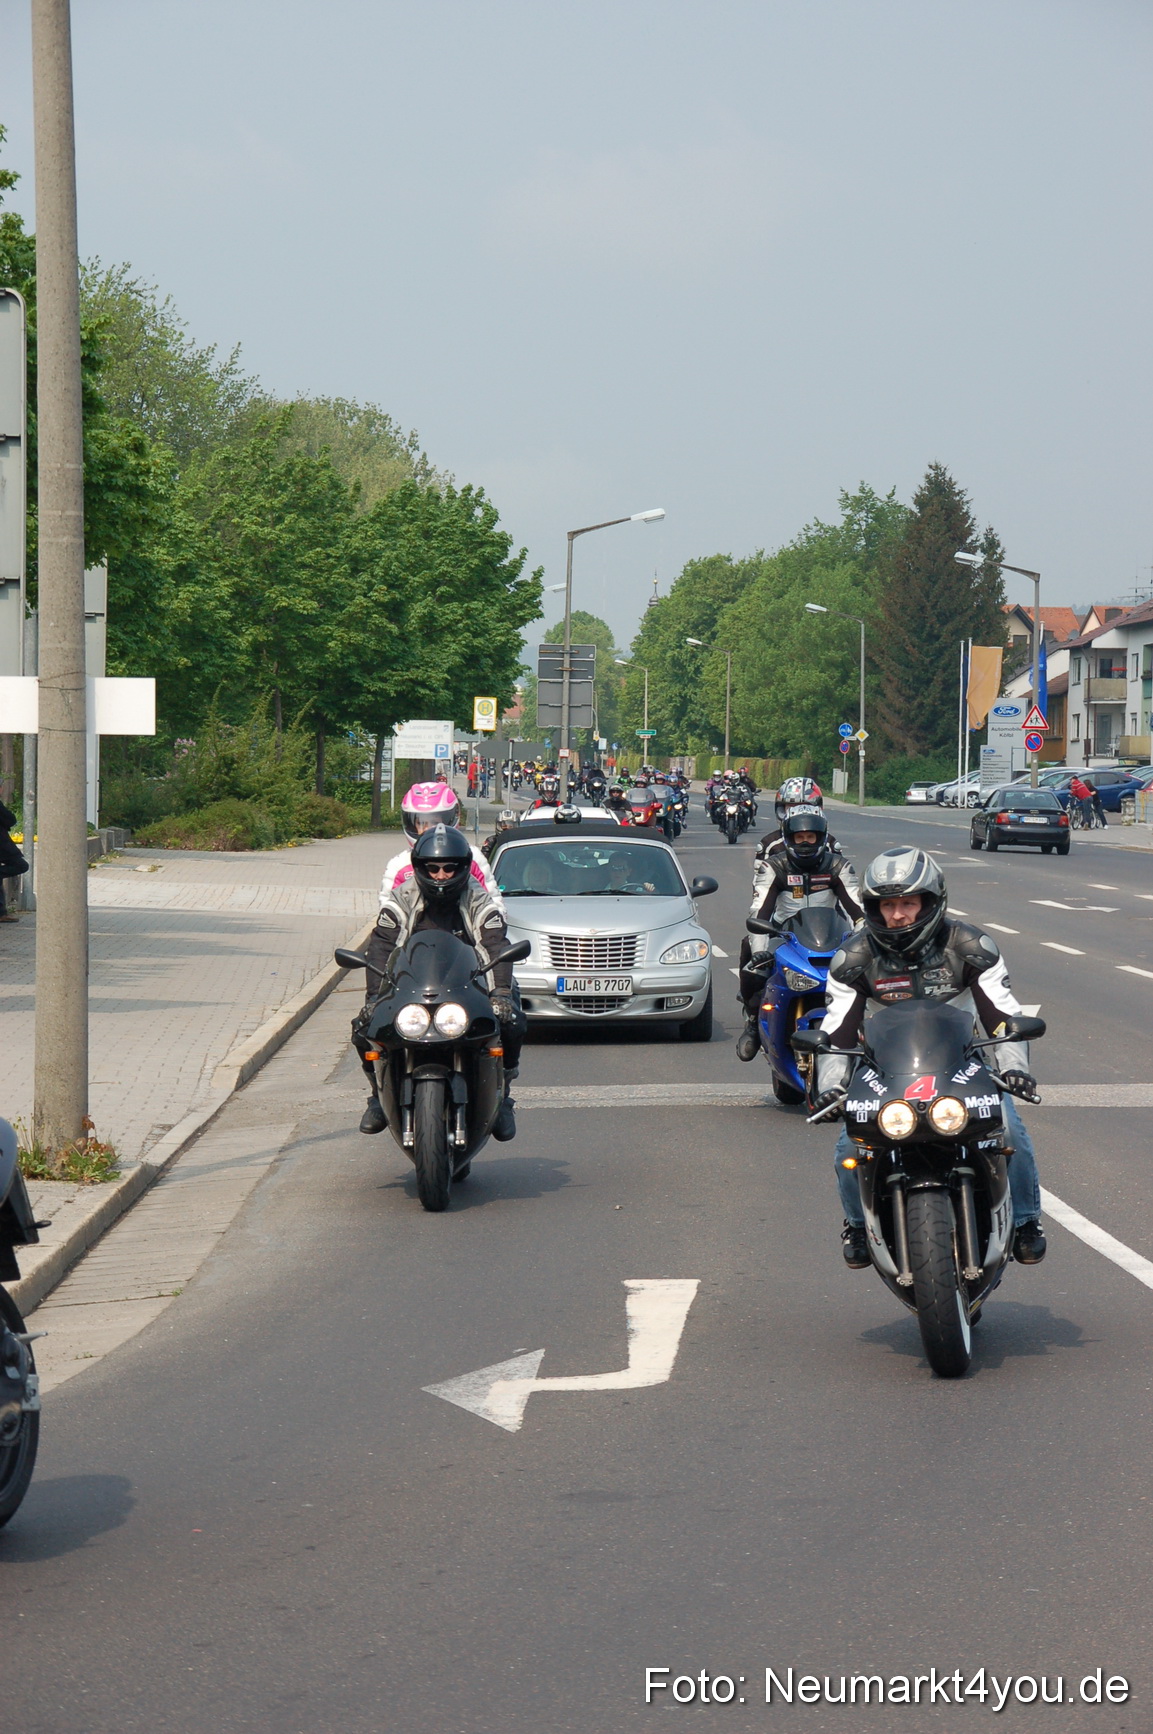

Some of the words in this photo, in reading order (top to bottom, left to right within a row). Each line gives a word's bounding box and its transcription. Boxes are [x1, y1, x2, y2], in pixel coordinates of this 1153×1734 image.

[995, 705, 1018, 715] Ford
[436, 745, 447, 757] P
[565, 979, 586, 992] LAU
[594, 979, 601, 992] B
[604, 979, 631, 992] 7707
[951, 1062, 982, 1086] West
[861, 1068, 888, 1097] West
[904, 1075, 938, 1102] 4
[846, 1099, 880, 1112] Mobil
[964, 1094, 1000, 1109] Mobil
